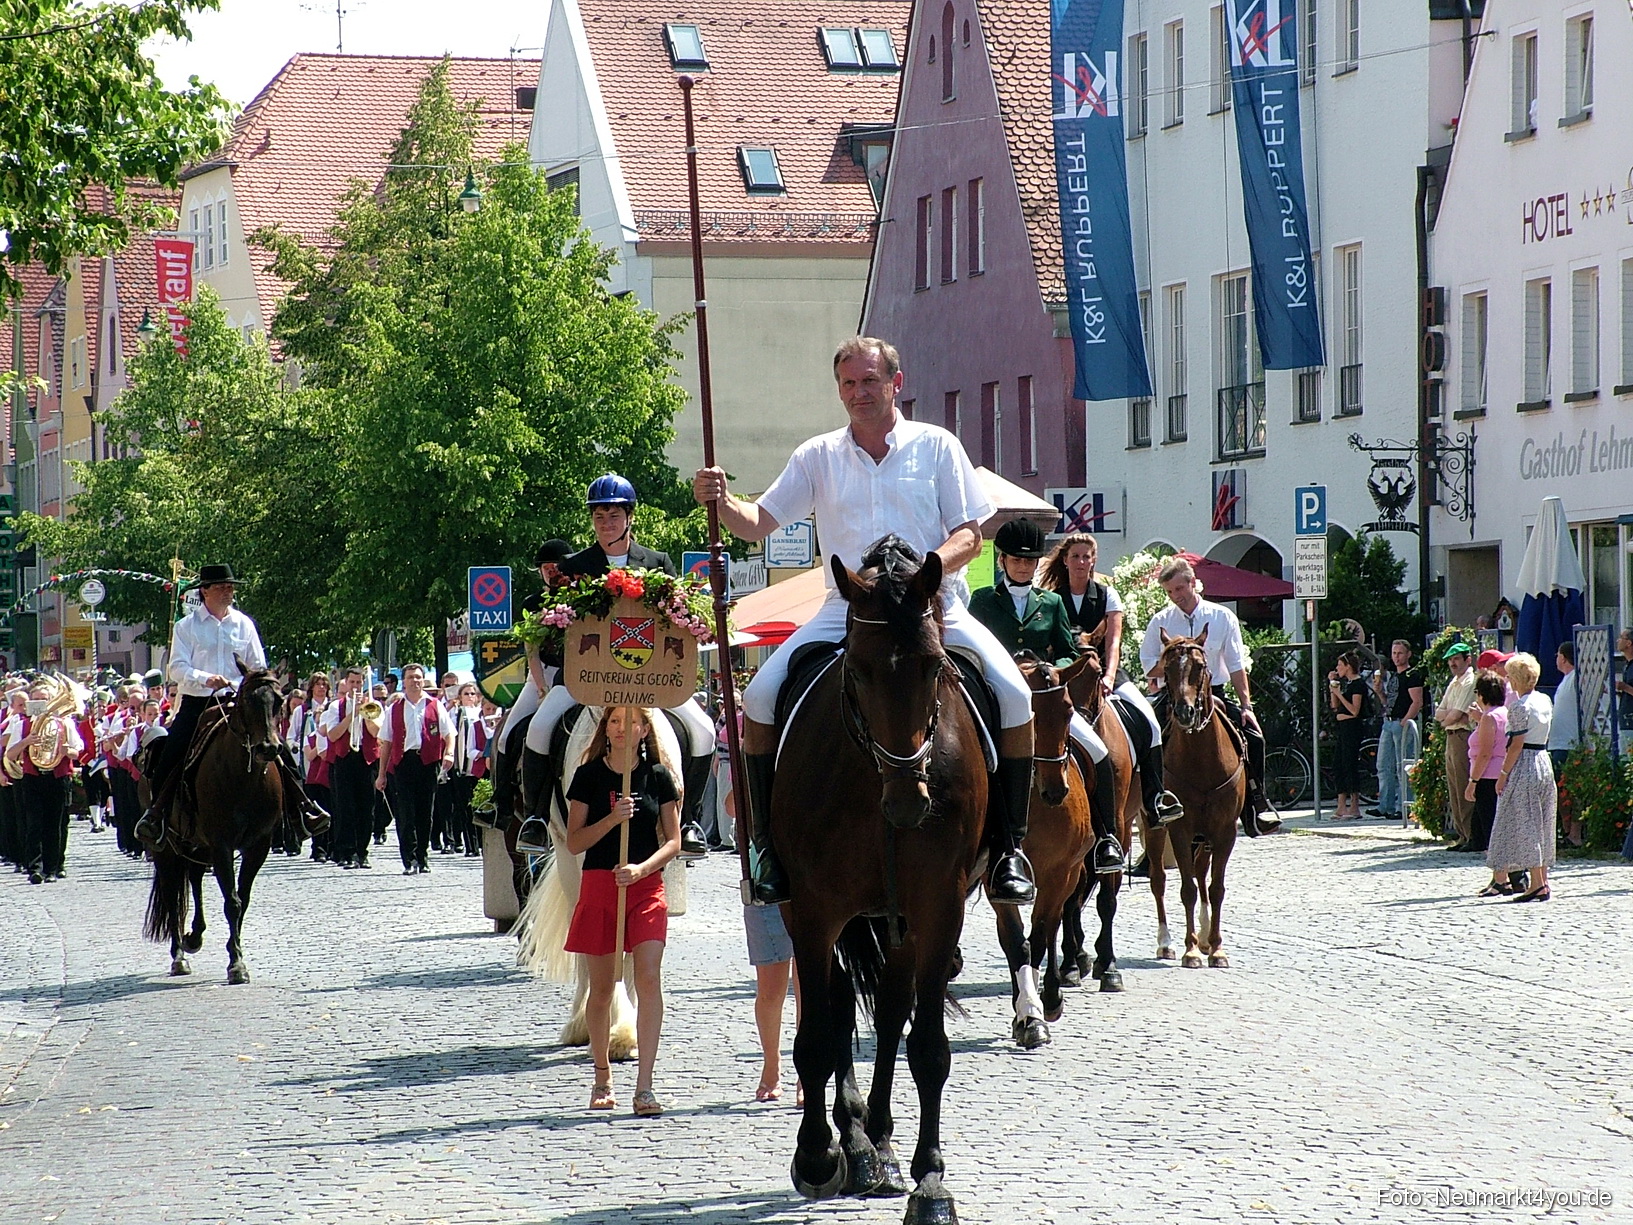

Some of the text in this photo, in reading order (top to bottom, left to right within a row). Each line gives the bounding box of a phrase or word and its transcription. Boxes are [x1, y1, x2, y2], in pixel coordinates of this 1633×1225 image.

[1523, 192, 1573, 244] HOTEL
[1422, 286, 1443, 506] HOTEL
[1520, 428, 1587, 480] Gasthof
[1302, 492, 1319, 529] P
[1311, 542, 1320, 550] mit
[1296, 552, 1325, 560] Parkschein
[1297, 563, 1324, 573] werktags
[473, 611, 507, 625] TAXI
[579, 669, 633, 684] REITVEREIN
[647, 672, 684, 687] GEORG
[604, 690, 655, 704] DEINING
